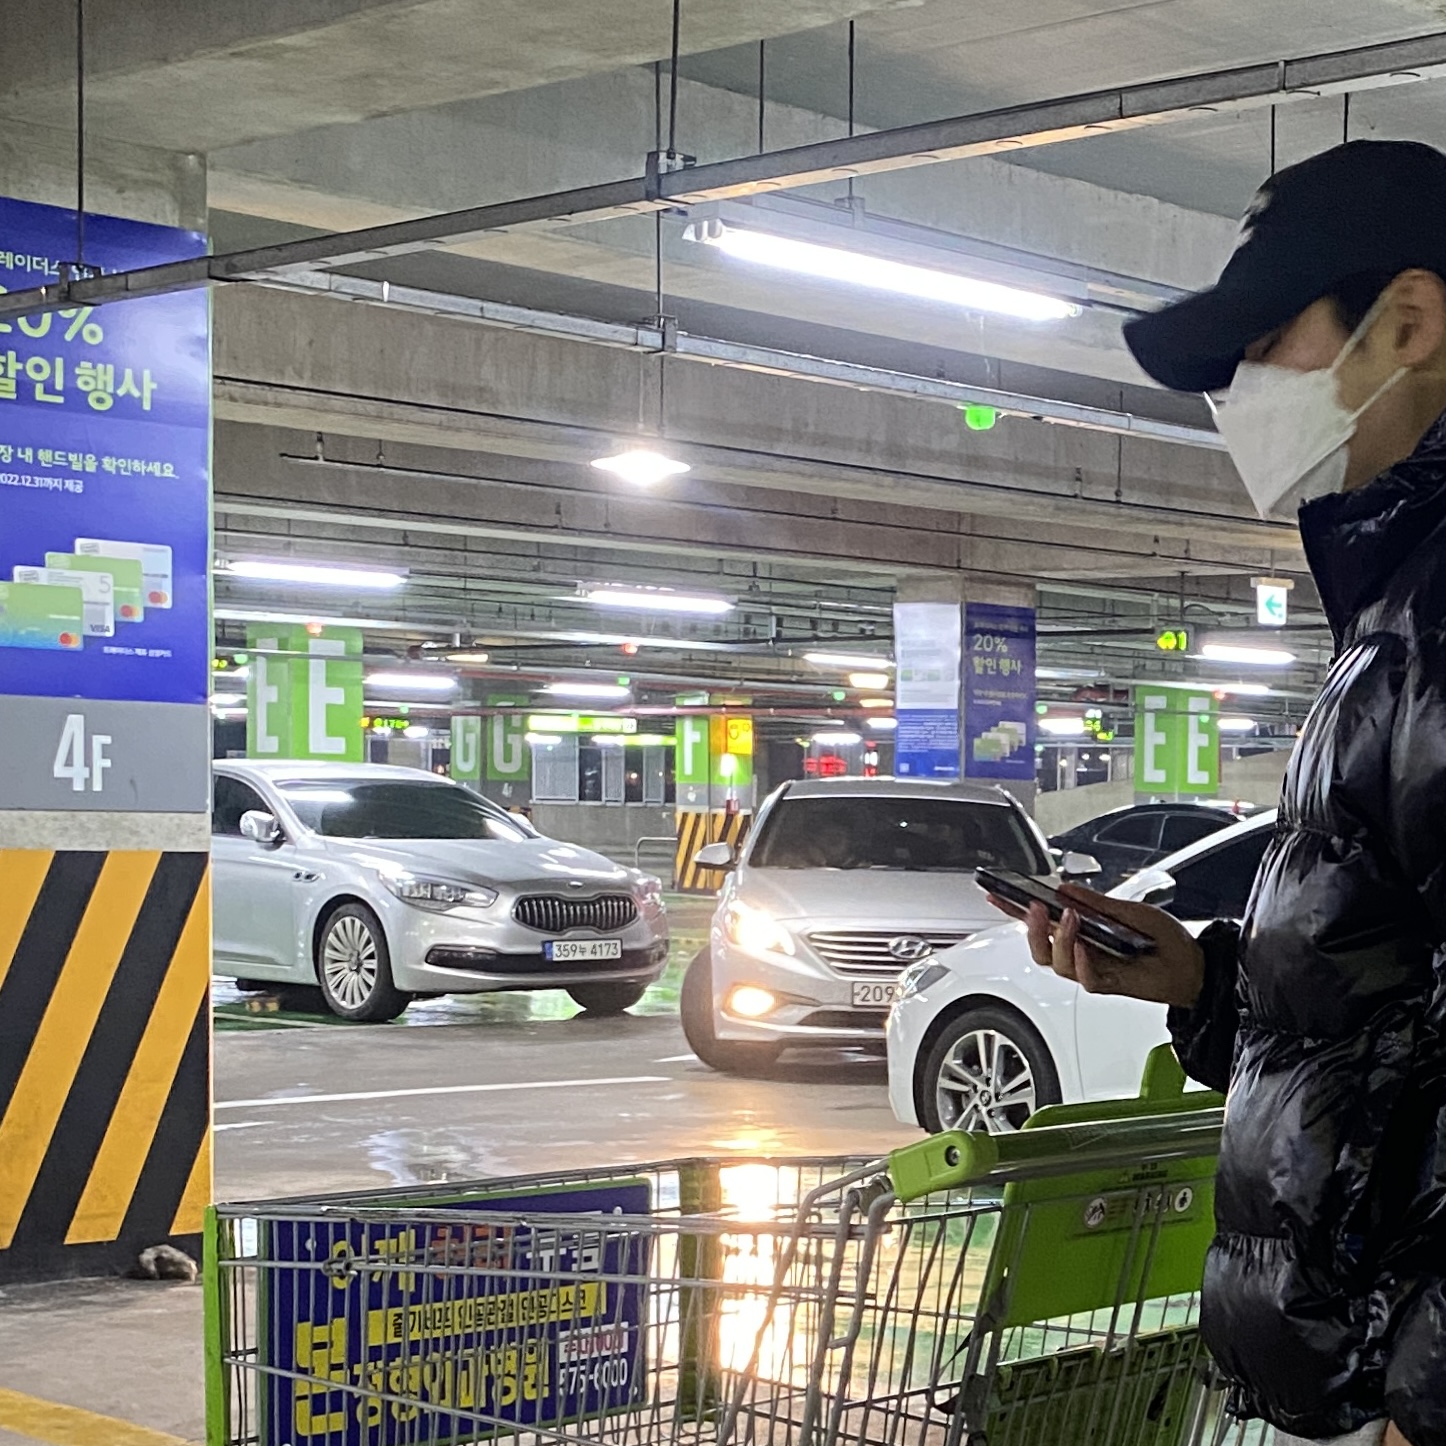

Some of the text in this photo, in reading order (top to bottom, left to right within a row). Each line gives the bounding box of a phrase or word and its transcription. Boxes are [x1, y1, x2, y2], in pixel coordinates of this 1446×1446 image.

[75, 361, 157, 411] 행사
[17, 447, 33, 464] 내
[973, 633, 1008, 653] 20%
[308, 638, 346, 754] E
[53, 713, 112, 791] 4F
[493, 701, 522, 773] G
[1143, 696, 1167, 783] E
[1187, 697, 1210, 784] E
